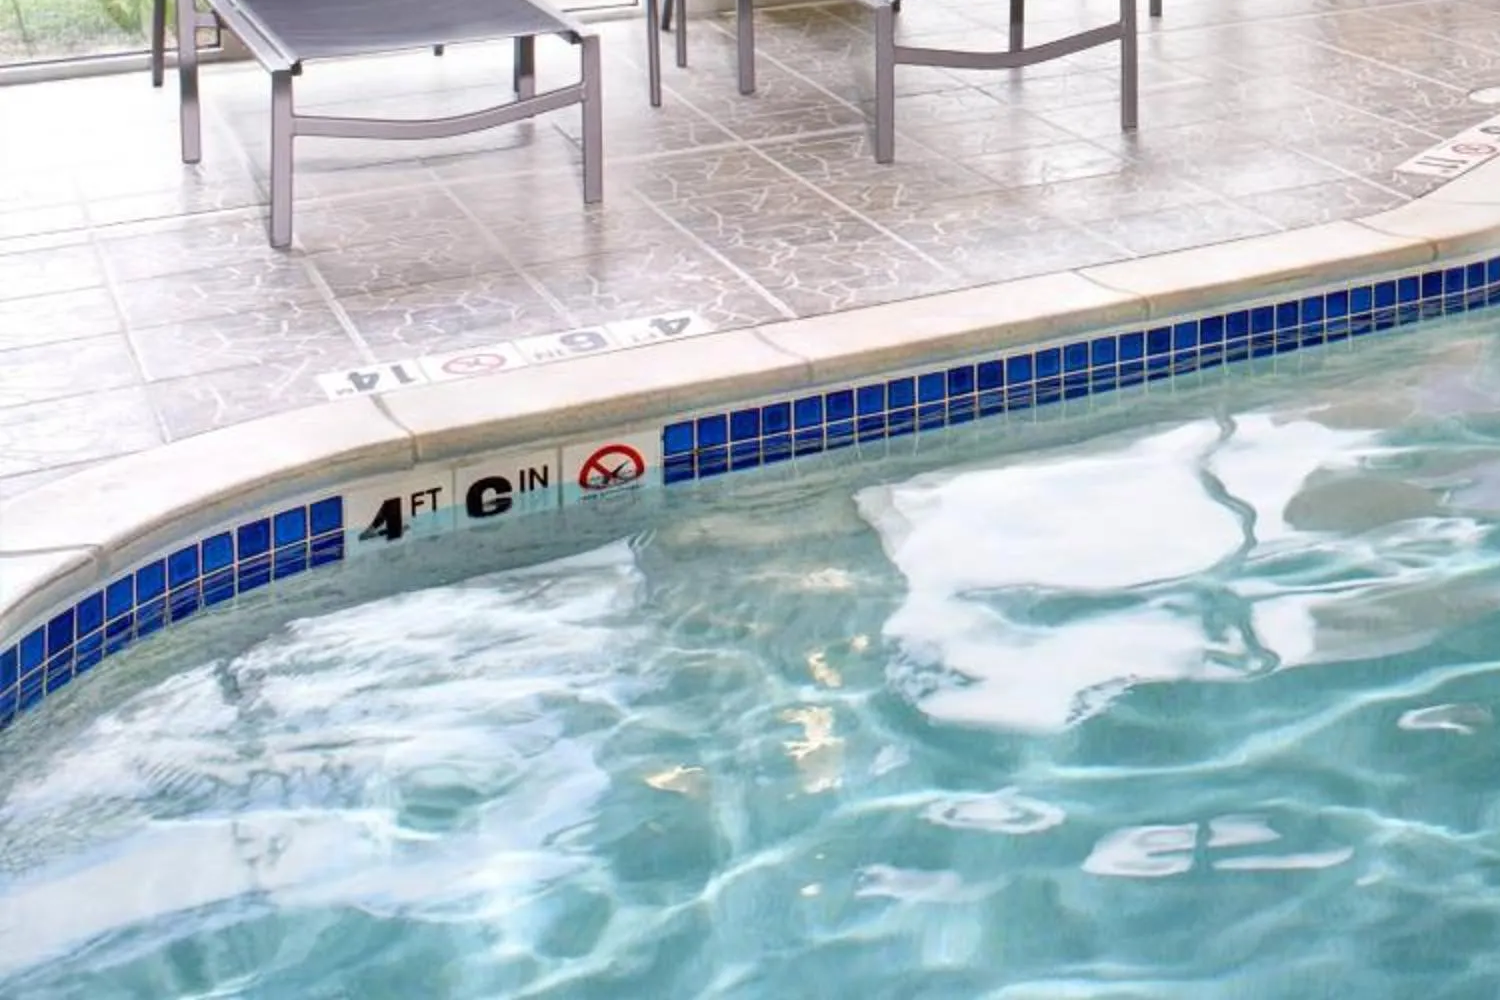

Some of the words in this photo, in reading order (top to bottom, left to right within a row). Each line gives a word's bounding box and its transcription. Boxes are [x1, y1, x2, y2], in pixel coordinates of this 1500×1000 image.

[649, 316, 691, 336] 4
[411, 487, 442, 517] FT
[519, 465, 549, 494] IN
